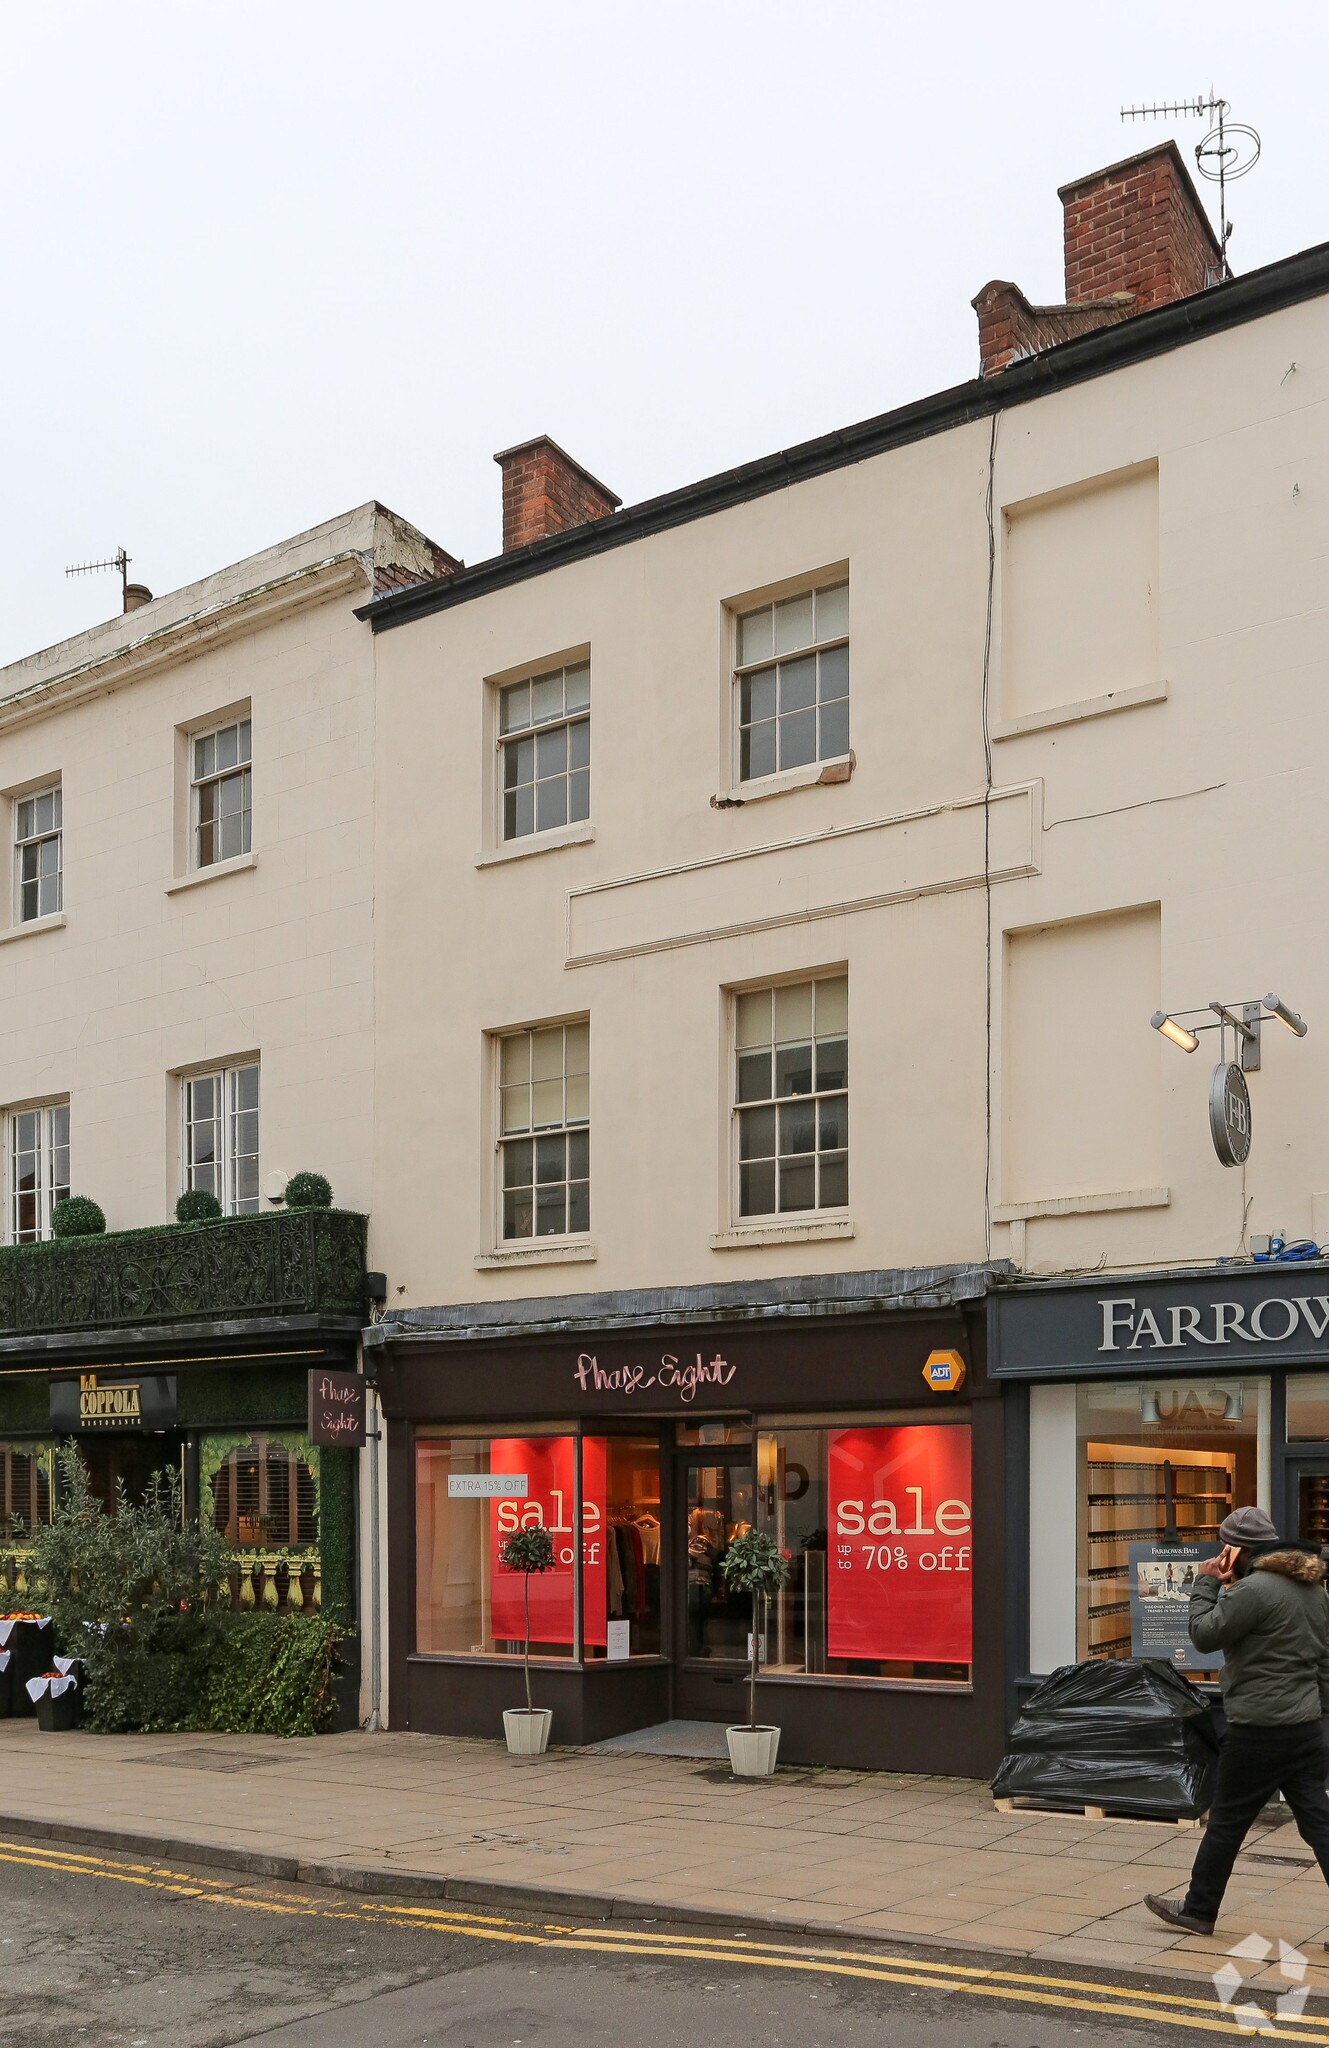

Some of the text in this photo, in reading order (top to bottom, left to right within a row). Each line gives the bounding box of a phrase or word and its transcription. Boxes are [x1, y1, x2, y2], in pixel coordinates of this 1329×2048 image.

[81, 1375, 97, 1390] LA
[574, 1353, 737, 1402] Phase Eight
[931, 1367, 950, 1378] ADT
[80, 1390, 140, 1414] COPPOLA
[319, 1377, 360, 1404] Phase
[81, 1418, 142, 1427] RISTORANTE
[321, 1410, 359, 1439] Eight
[449, 1480, 527, 1492] EXTRA 15% OFF
[497, 1490, 601, 1533] sale
[837, 1486, 971, 1536] sale
[837, 1544, 852, 1556] up
[861, 1545, 971, 1571] 70% off
[837, 1559, 852, 1569] to
